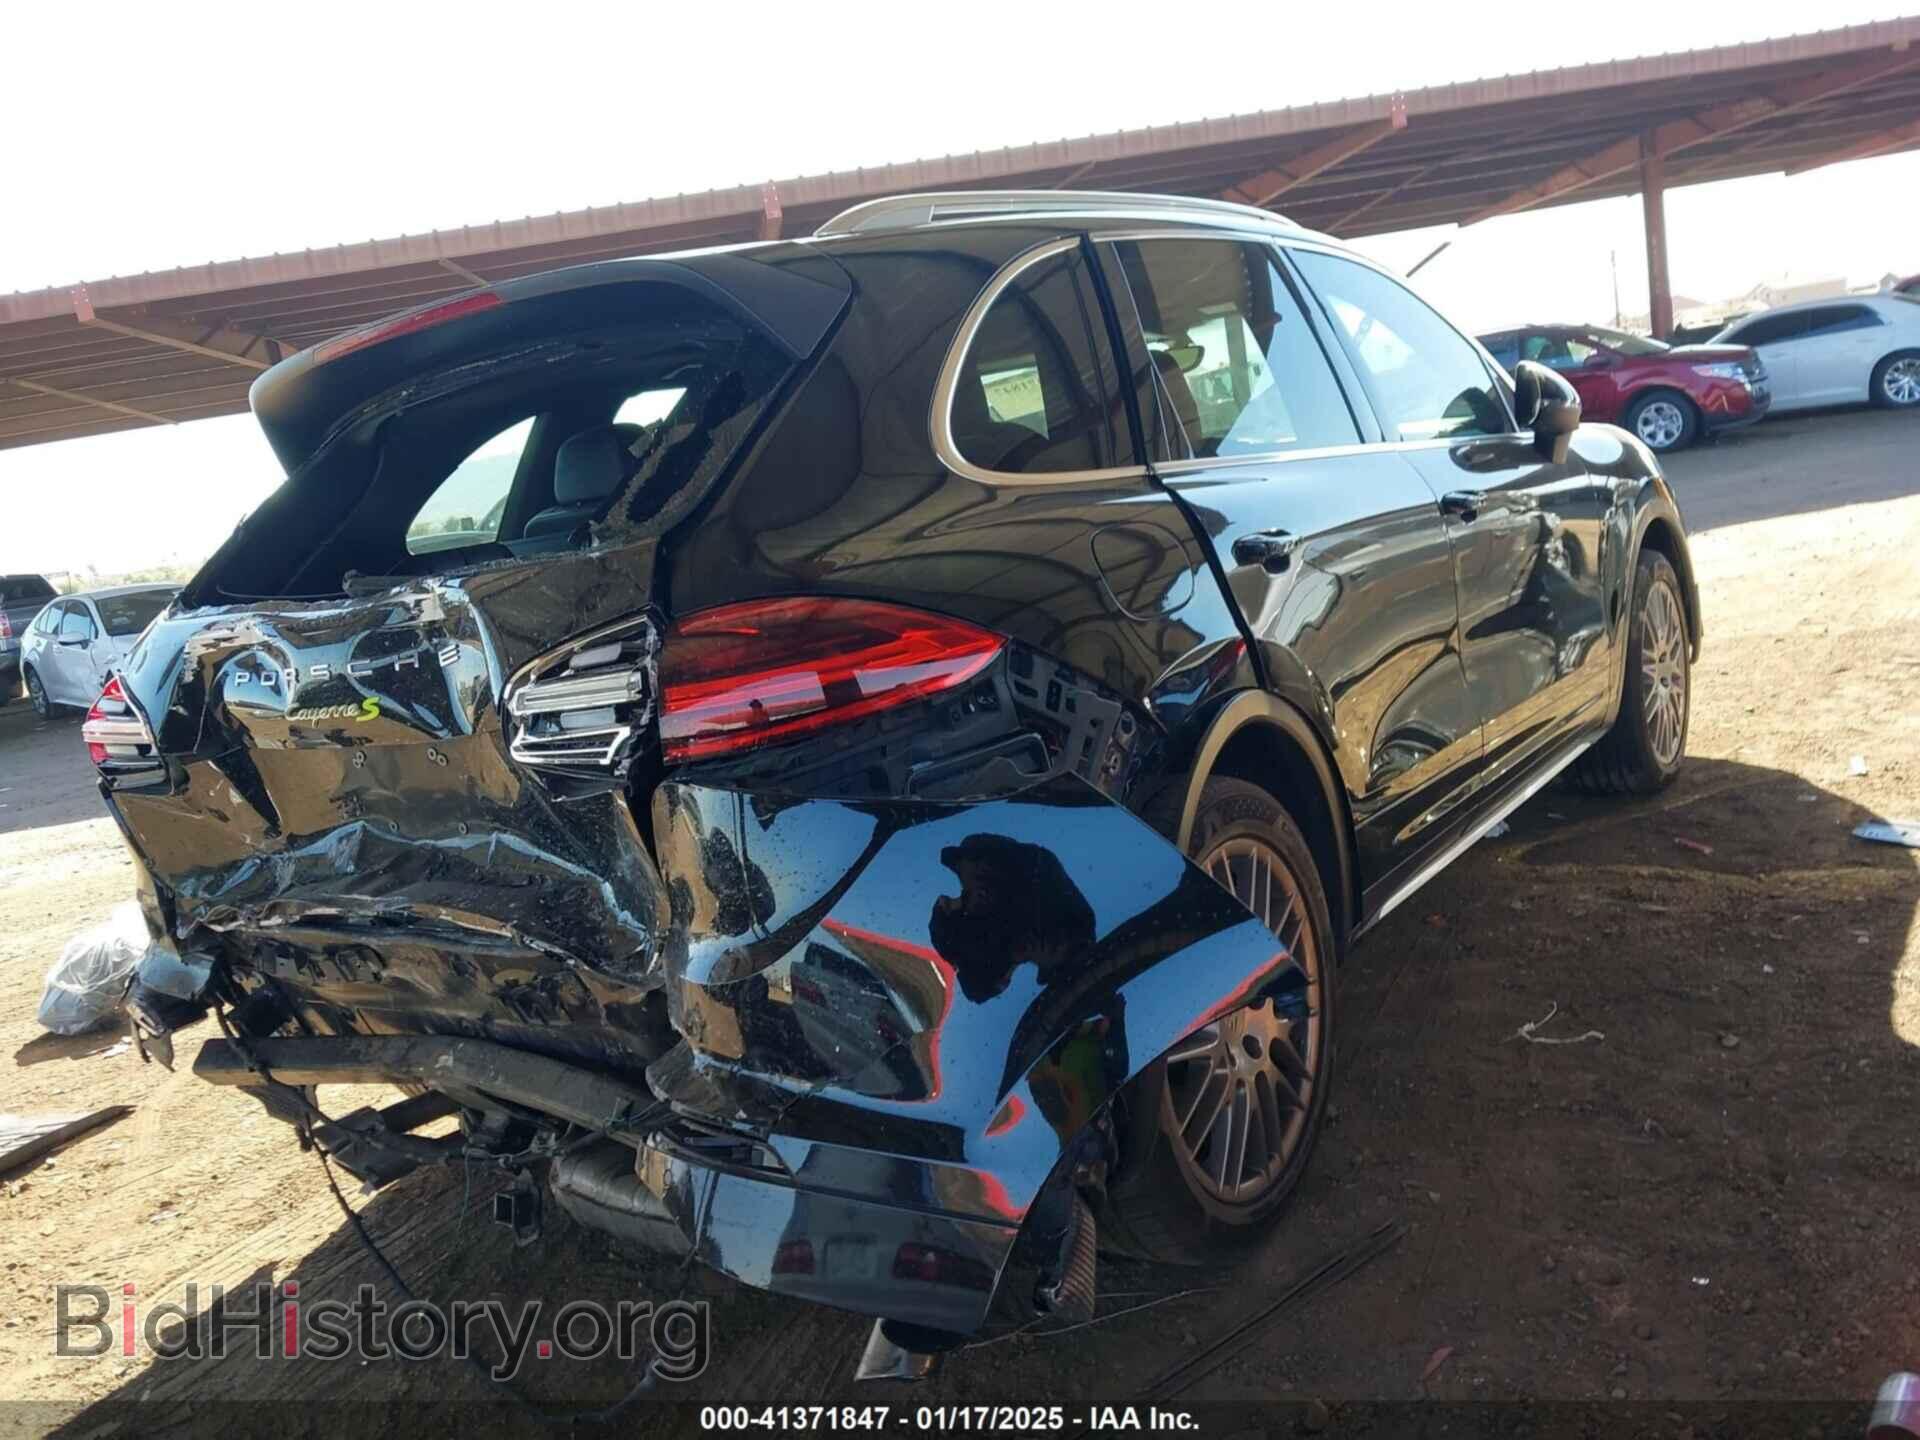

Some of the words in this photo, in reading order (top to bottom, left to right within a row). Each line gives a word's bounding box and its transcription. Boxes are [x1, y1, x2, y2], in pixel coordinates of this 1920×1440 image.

[234, 643, 461, 687] PORSCHE
[285, 702, 361, 728] Cayenne
[356, 696, 381, 722] S
